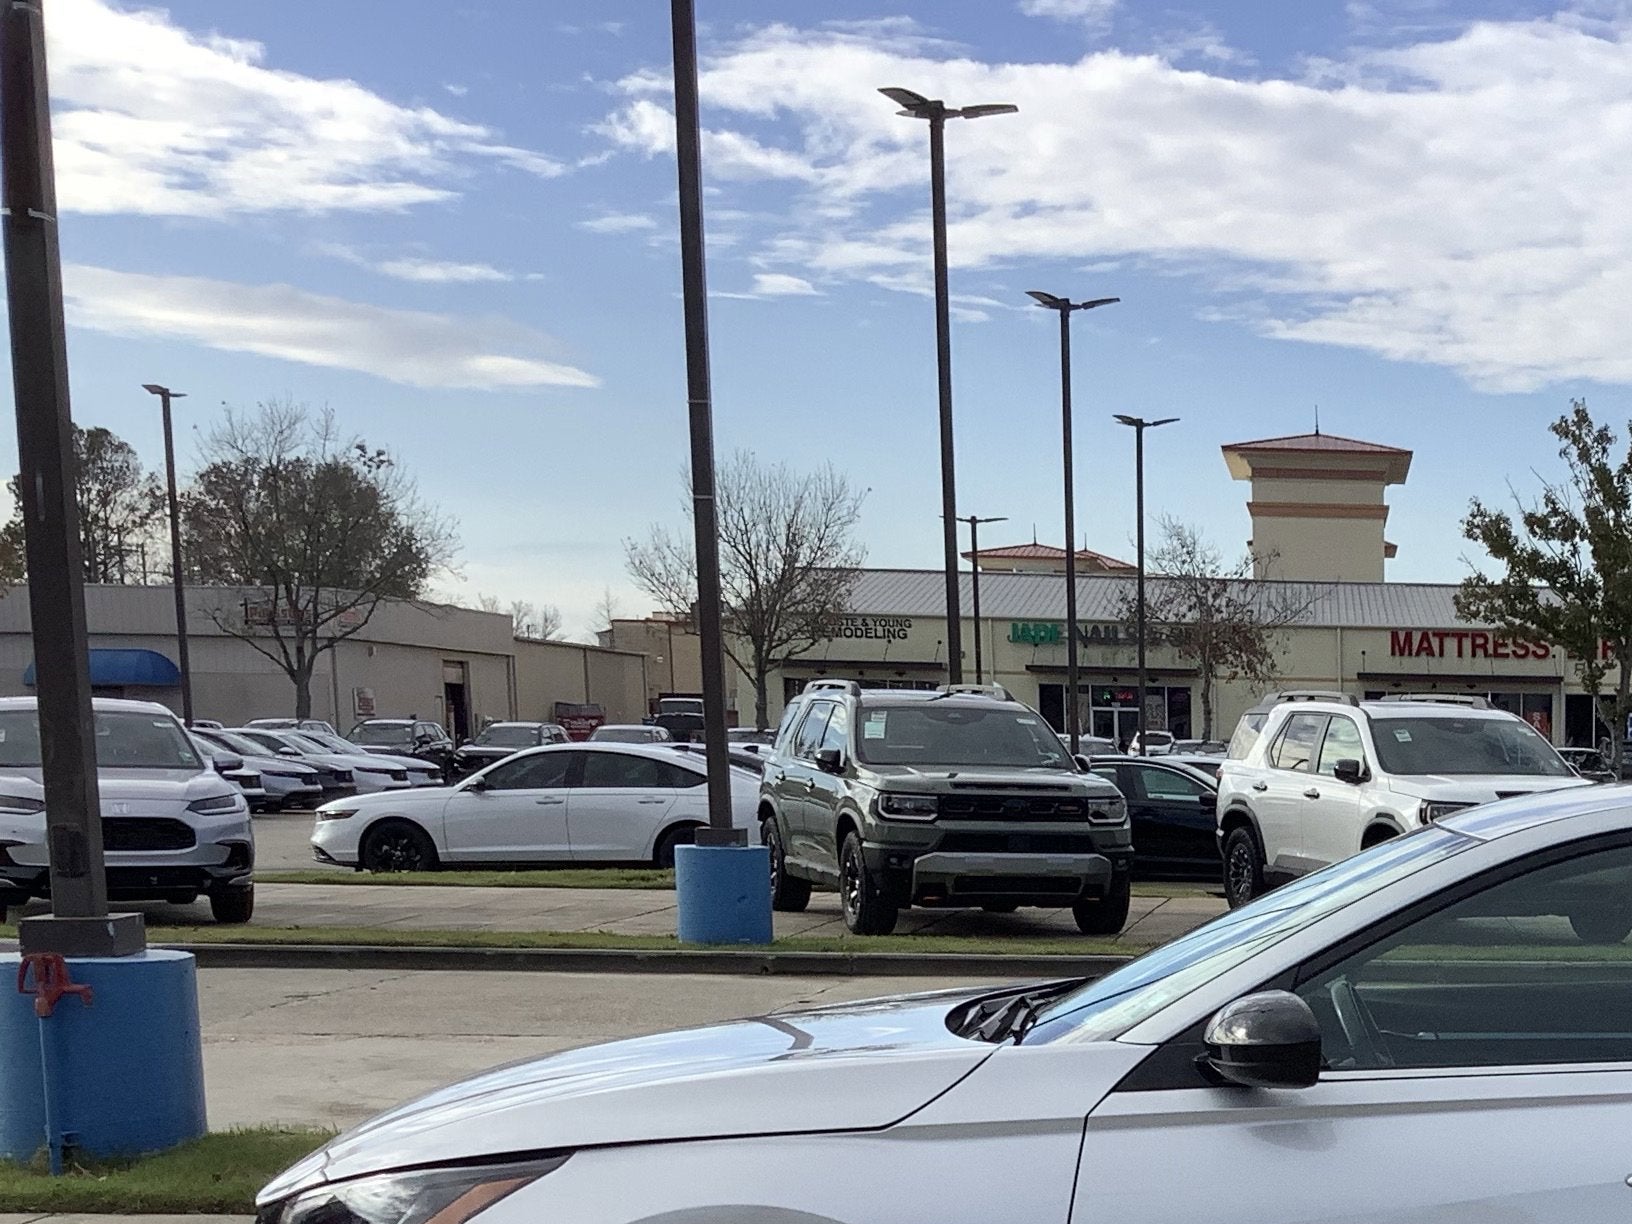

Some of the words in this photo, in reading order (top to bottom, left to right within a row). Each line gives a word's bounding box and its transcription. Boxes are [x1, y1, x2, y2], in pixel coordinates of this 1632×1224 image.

[872, 618, 912, 628] YOUNG
[822, 627, 908, 640] EMODELING
[1390, 630, 1551, 660] MATTRESS
